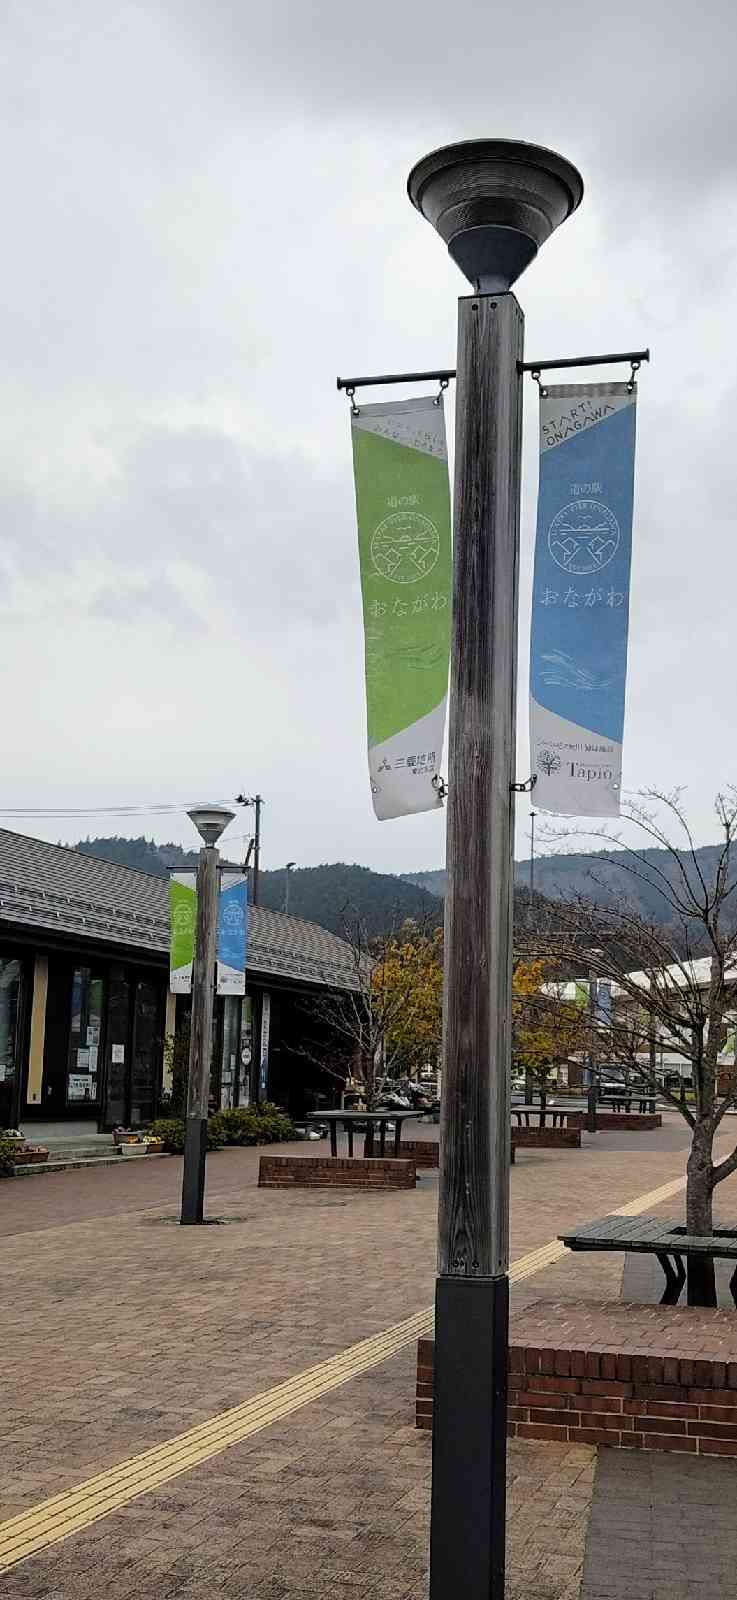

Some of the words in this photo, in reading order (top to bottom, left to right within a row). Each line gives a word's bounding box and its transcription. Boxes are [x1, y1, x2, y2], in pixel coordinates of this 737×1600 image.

[546, 404, 615, 446] ONAGAWA
[367, 592, 449, 617] おながわ
[540, 585, 624, 608] おながわ
[566, 761, 612, 781] Tapio
